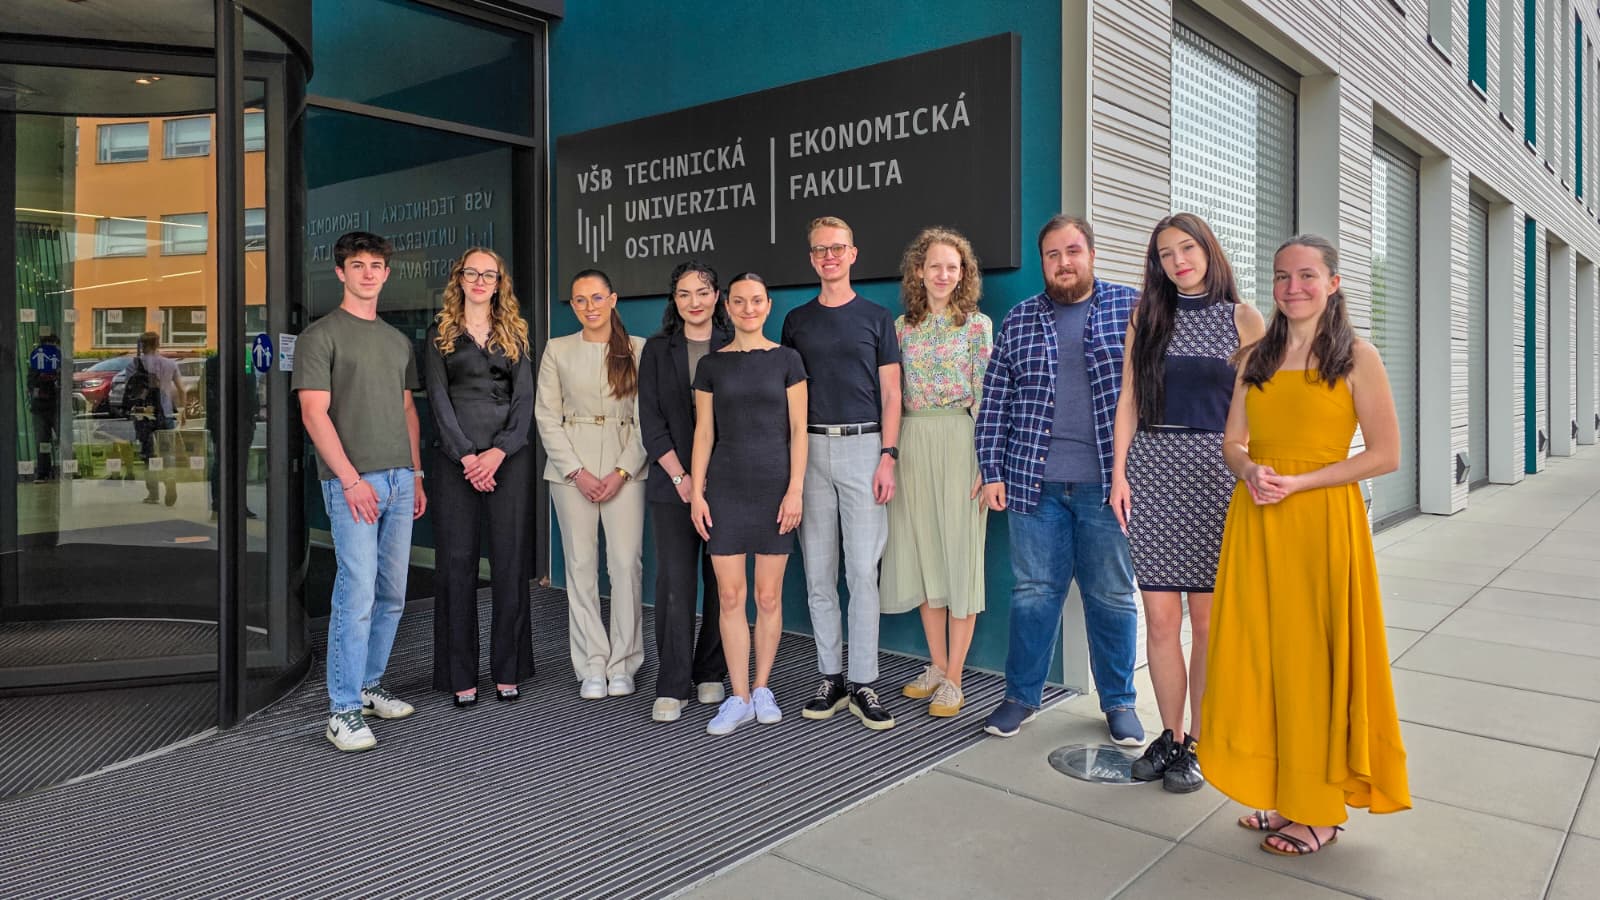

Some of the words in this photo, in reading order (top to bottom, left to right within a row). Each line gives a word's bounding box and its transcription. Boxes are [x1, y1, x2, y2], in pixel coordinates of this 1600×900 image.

[790, 91, 970, 158] EKONOMICKÁ
[577, 164, 613, 194] VŠB
[624, 136, 745, 186] TECHNICKÁ
[790, 158, 903, 200] FAKULTA
[625, 182, 756, 222] UNIVERZITA
[625, 228, 715, 259] OSTRAVA
